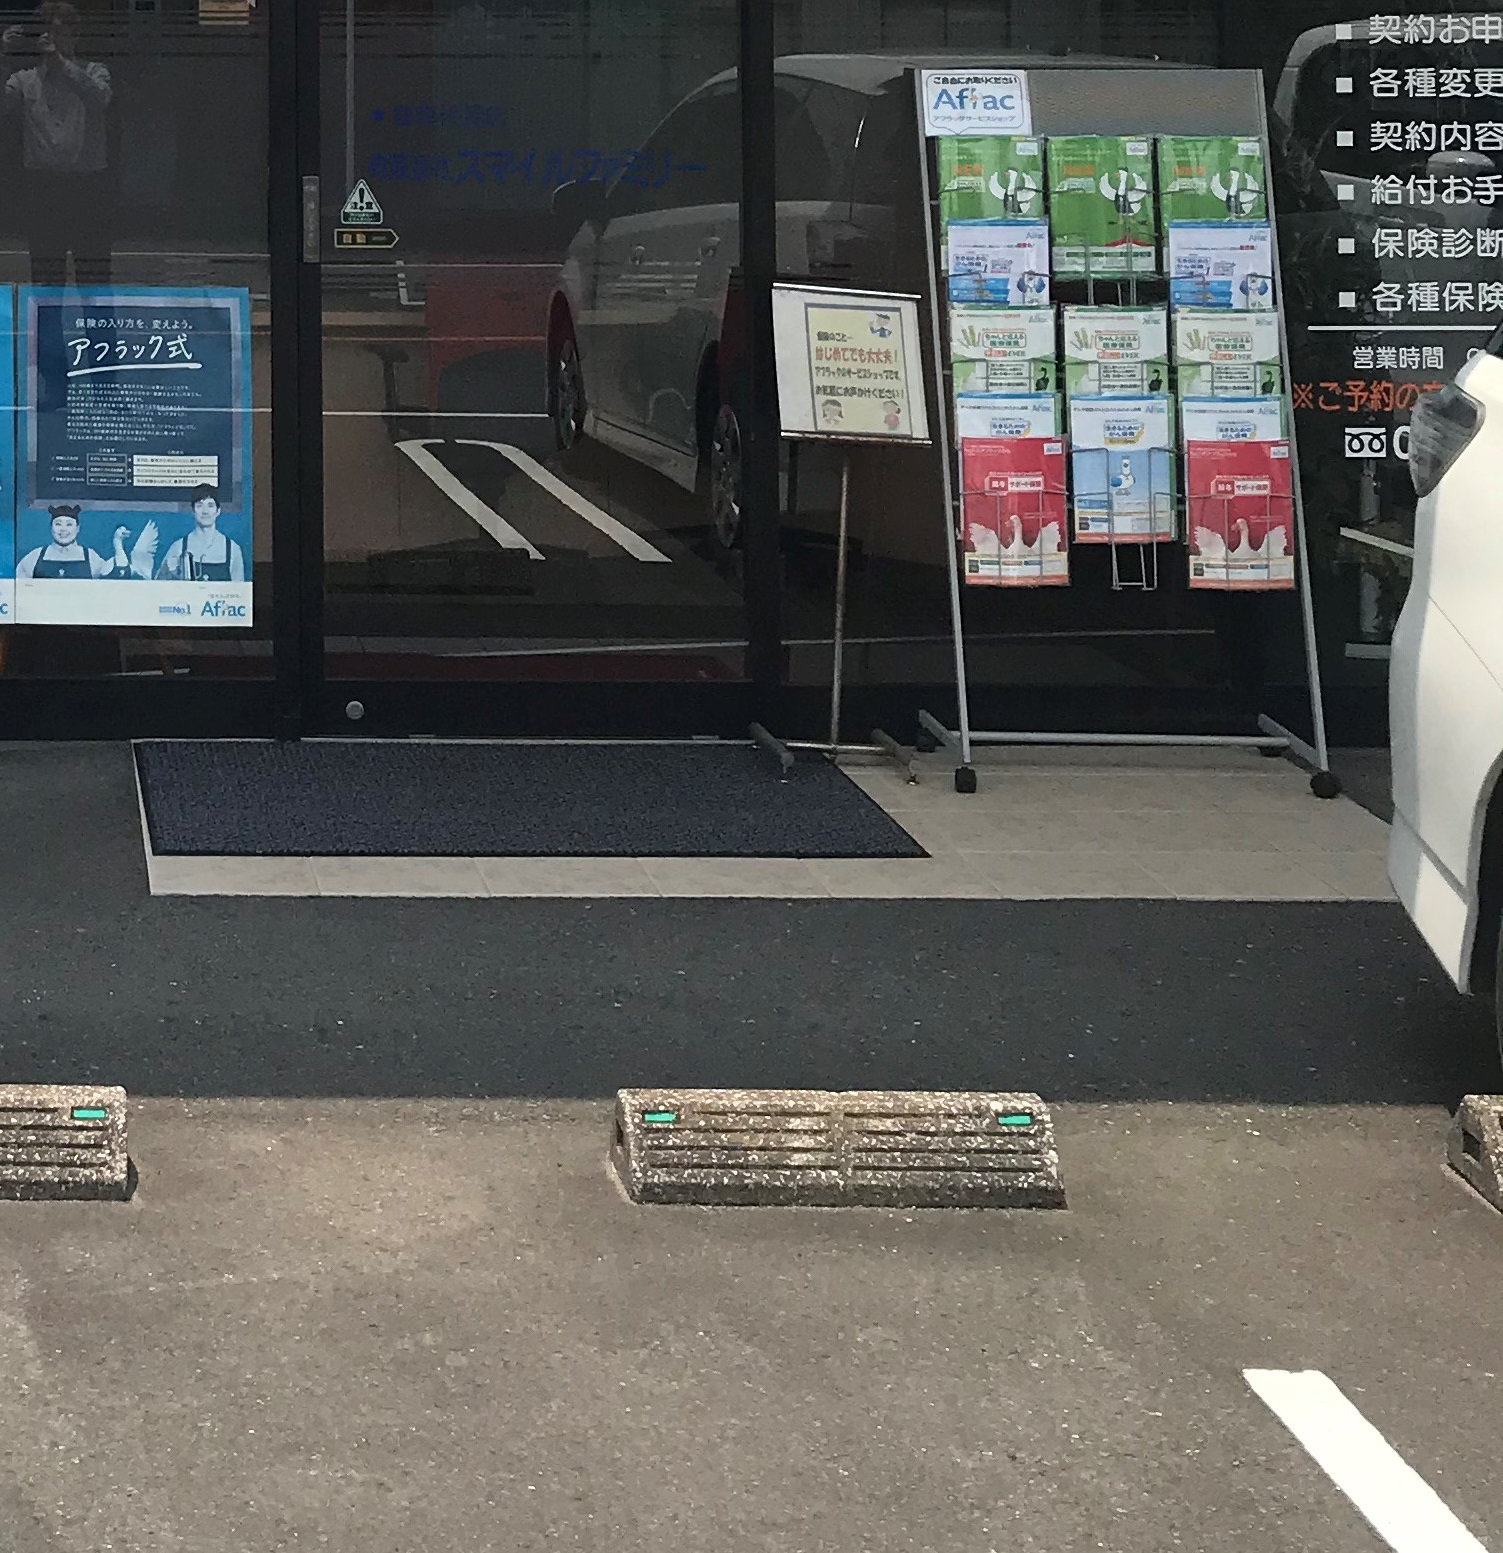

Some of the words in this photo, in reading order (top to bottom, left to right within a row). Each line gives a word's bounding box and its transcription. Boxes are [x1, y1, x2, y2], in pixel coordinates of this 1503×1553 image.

[1368, 13, 1503, 45] 契約お申
[1368, 67, 1503, 98] 各種変更
[1369, 120, 1503, 152] 契約内容
[1370, 173, 1503, 205] 給付お手
[1371, 227, 1503, 259] 保険診断
[1371, 281, 1503, 313] 各種保険
[75, 317, 194, 330] 保険の入り方を、変えよう。
[67, 333, 194, 366] アフラック式
[1352, 346, 1445, 370] 営業時間
[1292, 379, 1445, 413] ※ご予約の
